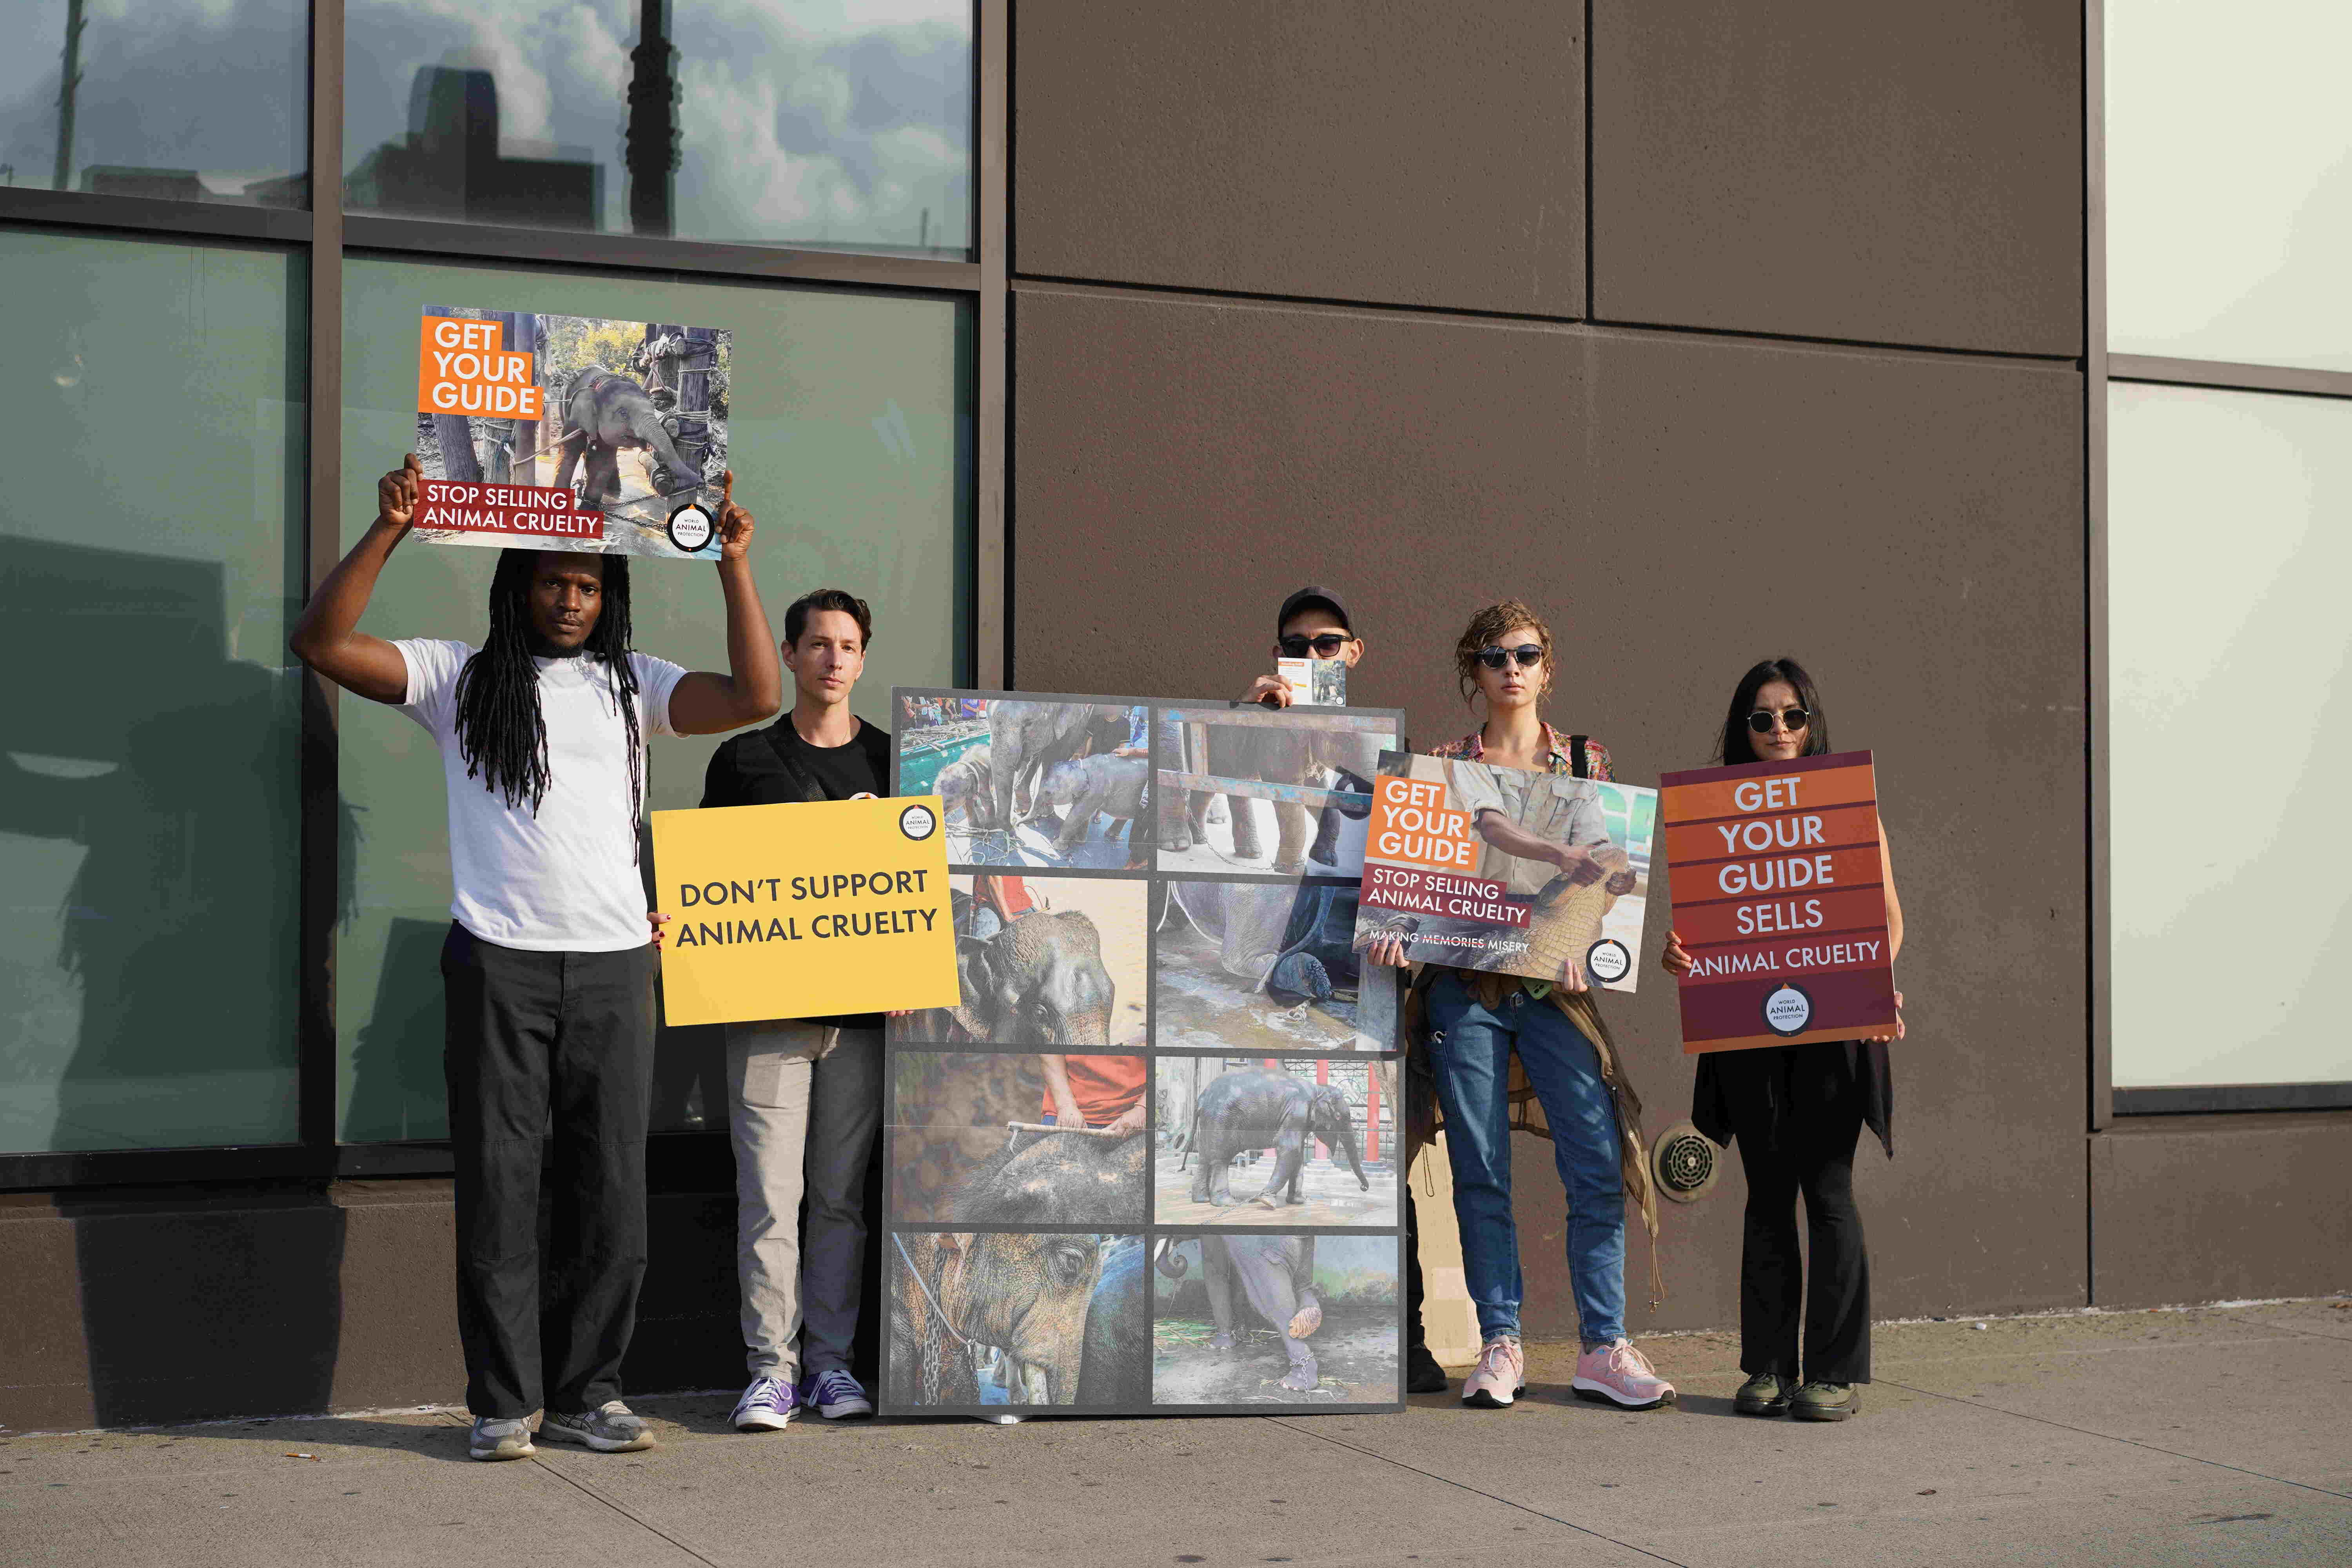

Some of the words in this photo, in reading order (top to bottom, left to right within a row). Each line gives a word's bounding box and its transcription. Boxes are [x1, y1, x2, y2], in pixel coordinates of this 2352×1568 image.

[434, 321, 496, 351] GET
[433, 351, 526, 383] YOUR
[432, 382, 535, 414] GUIDE
[426, 485, 479, 504] STOP
[485, 488, 568, 510] SELLING
[423, 507, 508, 529] ANIMAL
[514, 512, 599, 534] CRUELTY
[1385, 780, 1440, 808] GET
[1735, 777, 1800, 811] GET
[1382, 804, 1464, 838] YOUR
[1718, 816, 1825, 853] YOUR
[1378, 831, 1471, 865] GUIDE
[681, 878, 780, 907] DON'T
[791, 869, 927, 900] SUPPORT
[1373, 868, 1419, 888] STOP
[1425, 875, 1499, 900] SELLING
[1719, 855, 1834, 894] GUIDE
[1367, 888, 1443, 912] ANIMAL
[1448, 898, 1527, 924] CRUELTY
[1737, 899, 1823, 934] SELLS
[676, 917, 802, 947] ANIMAL
[811, 909, 937, 938] CRUELTY
[1422, 935, 1485, 948] MEMORIES
[1488, 942, 1530, 953] MISERY
[1594, 956, 1622, 965] ANIMAL
[1689, 951, 1779, 977] ANIMAL
[1786, 941, 1879, 968] CRUELTY
[1770, 1004, 1805, 1014] ANIMAL
